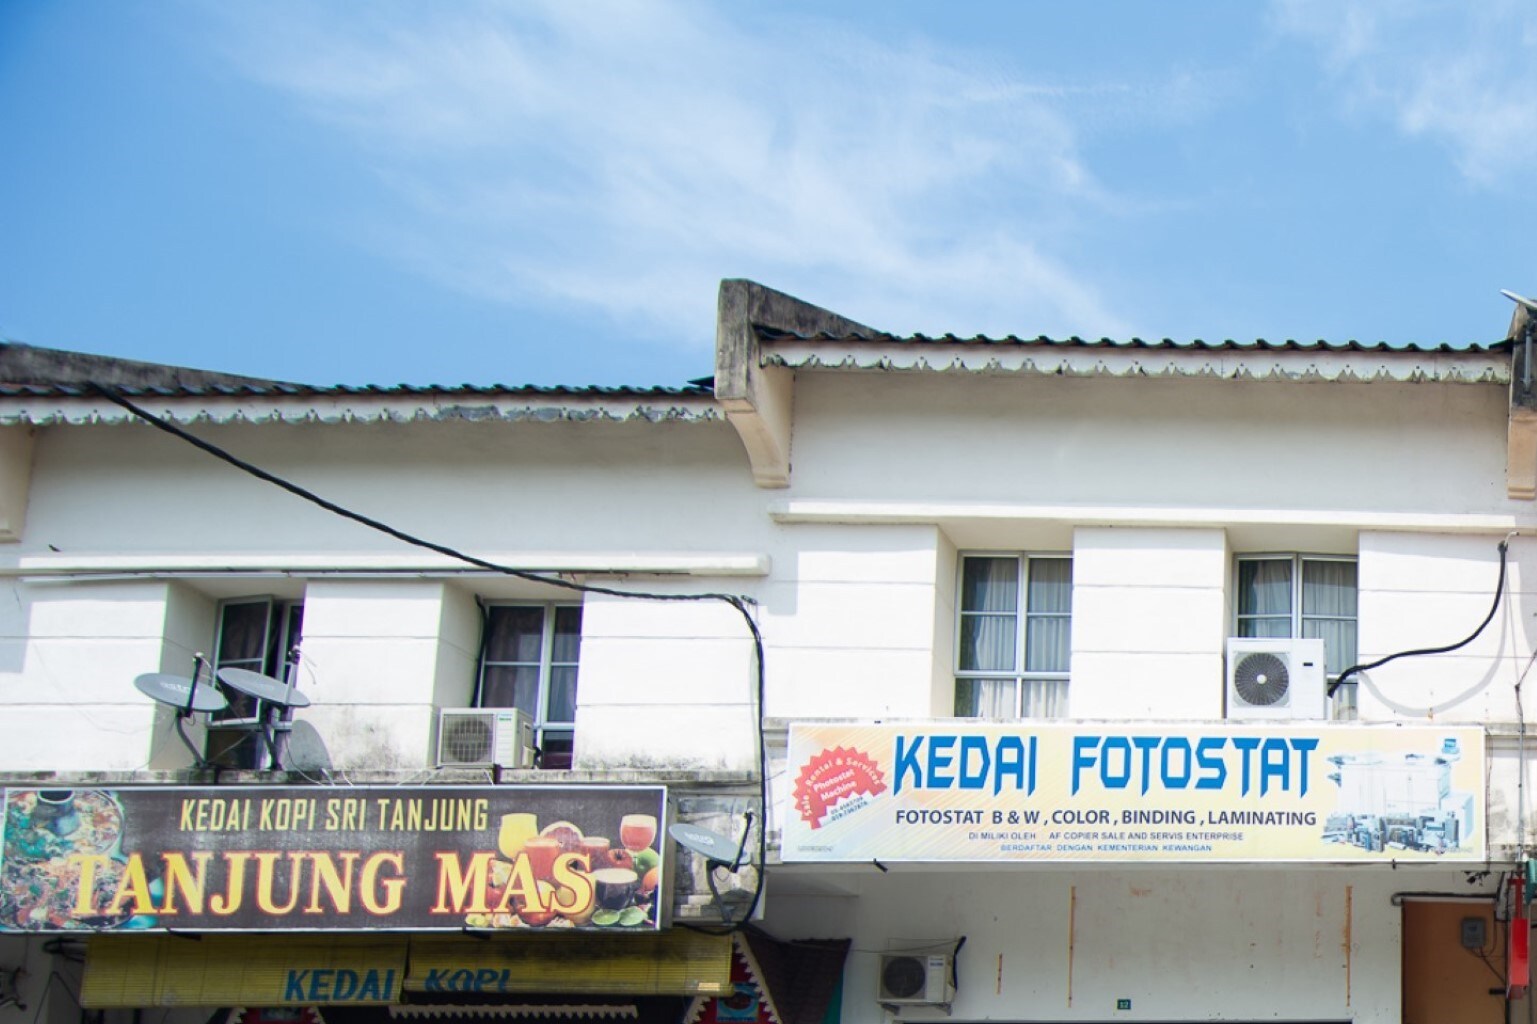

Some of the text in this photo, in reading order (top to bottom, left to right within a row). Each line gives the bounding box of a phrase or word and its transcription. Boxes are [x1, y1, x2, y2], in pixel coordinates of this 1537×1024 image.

[892, 735, 1320, 797] KEDAI FOTOSTAT
[180, 798, 488, 831] KEDAI KOPI SRI TANJUNG
[896, 810, 983, 825] FOTOSTAT
[992, 811, 1004, 825] B
[1006, 811, 1020, 825] &
[1208, 811, 1316, 826] LAMINATING
[968, 832, 979, 840] DI
[1011, 832, 1036, 840] OLEH
[1049, 832, 1061, 840] AF
[1064, 832, 1098, 840] COPIER
[1101, 832, 1125, 840] SALE
[1128, 832, 1147, 840] AND
[1149, 832, 1183, 840] SERVIS
[1186, 832, 1243, 841] ENTERPRISE
[68, 850, 596, 918] TANJUNG MAS
[284, 968, 512, 1000] KEDAI KOPI
